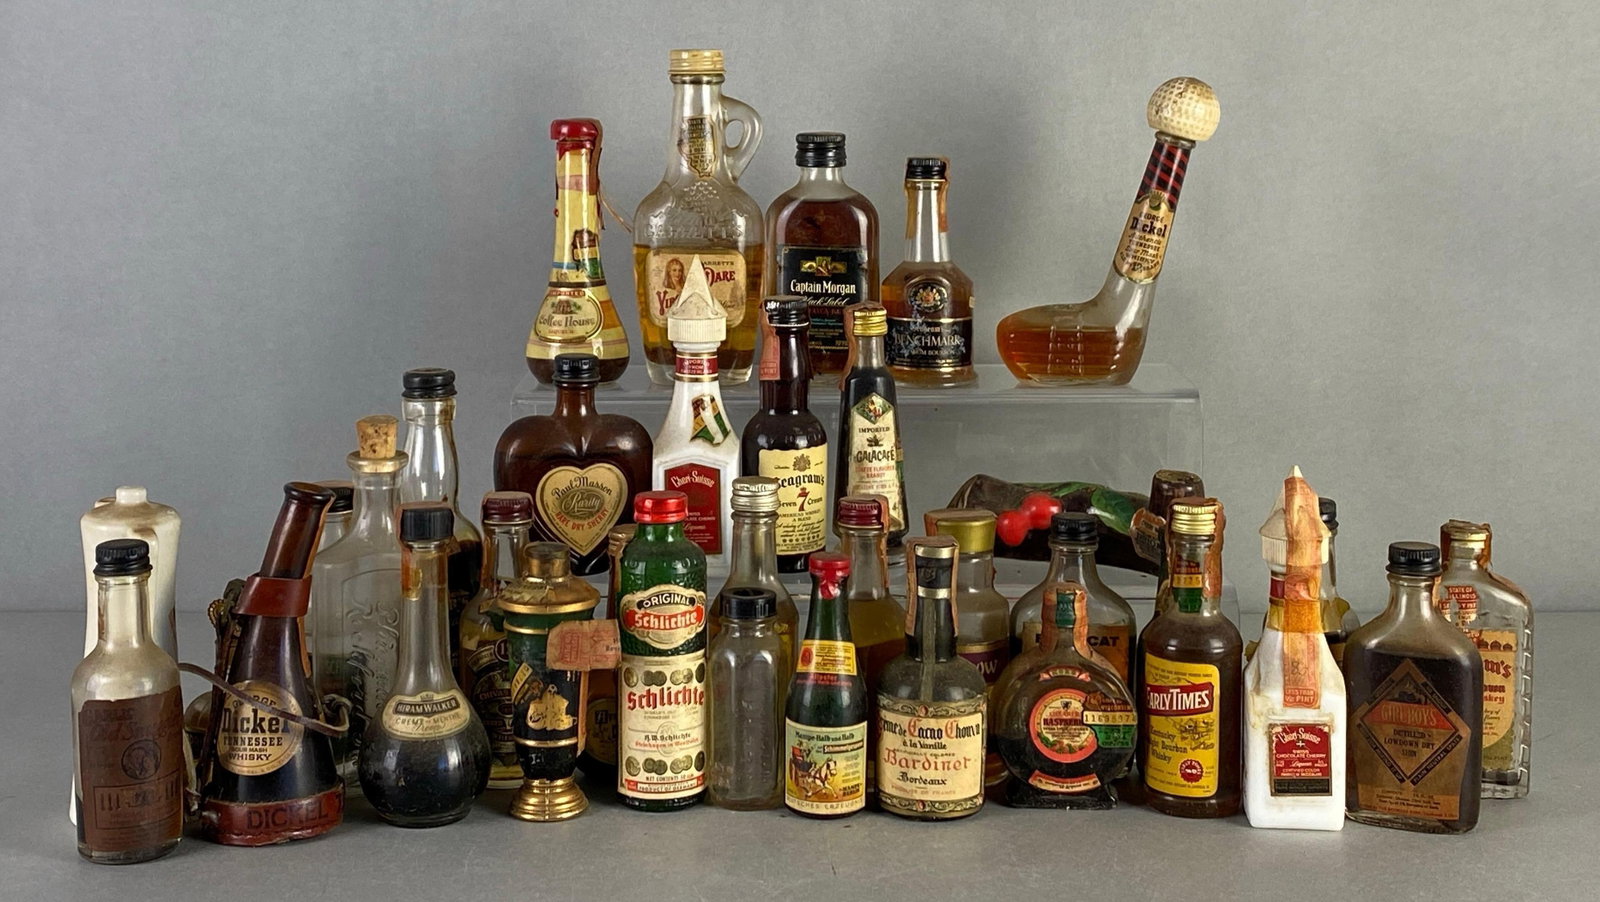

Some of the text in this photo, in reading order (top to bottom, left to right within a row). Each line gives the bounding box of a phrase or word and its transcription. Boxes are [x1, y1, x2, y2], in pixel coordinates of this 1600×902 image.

[1130, 217, 1168, 238] Dckel
[790, 279, 857, 295] Captain Morgan
[539, 315, 596, 328] Coffee House
[551, 476, 613, 500] Paul Masson
[779, 474, 824, 490] eagram's
[561, 491, 601, 514] Rarity
[797, 490, 810, 512] 7
[571, 522, 586, 531] DRY
[586, 509, 610, 529] SHERRY
[643, 593, 690, 608] ORIGINAL
[634, 610, 698, 630] Schlichte
[396, 698, 457, 714] HIRAM WALKER
[627, 685, 705, 711] Schlichte
[1169, 688, 1210, 710] TIMES
[223, 736, 283, 747] TENNESSEE
[228, 753, 272, 761] WHISKY
[883, 748, 971, 771] Bardinet
[897, 771, 948, 786] Bordeaux
